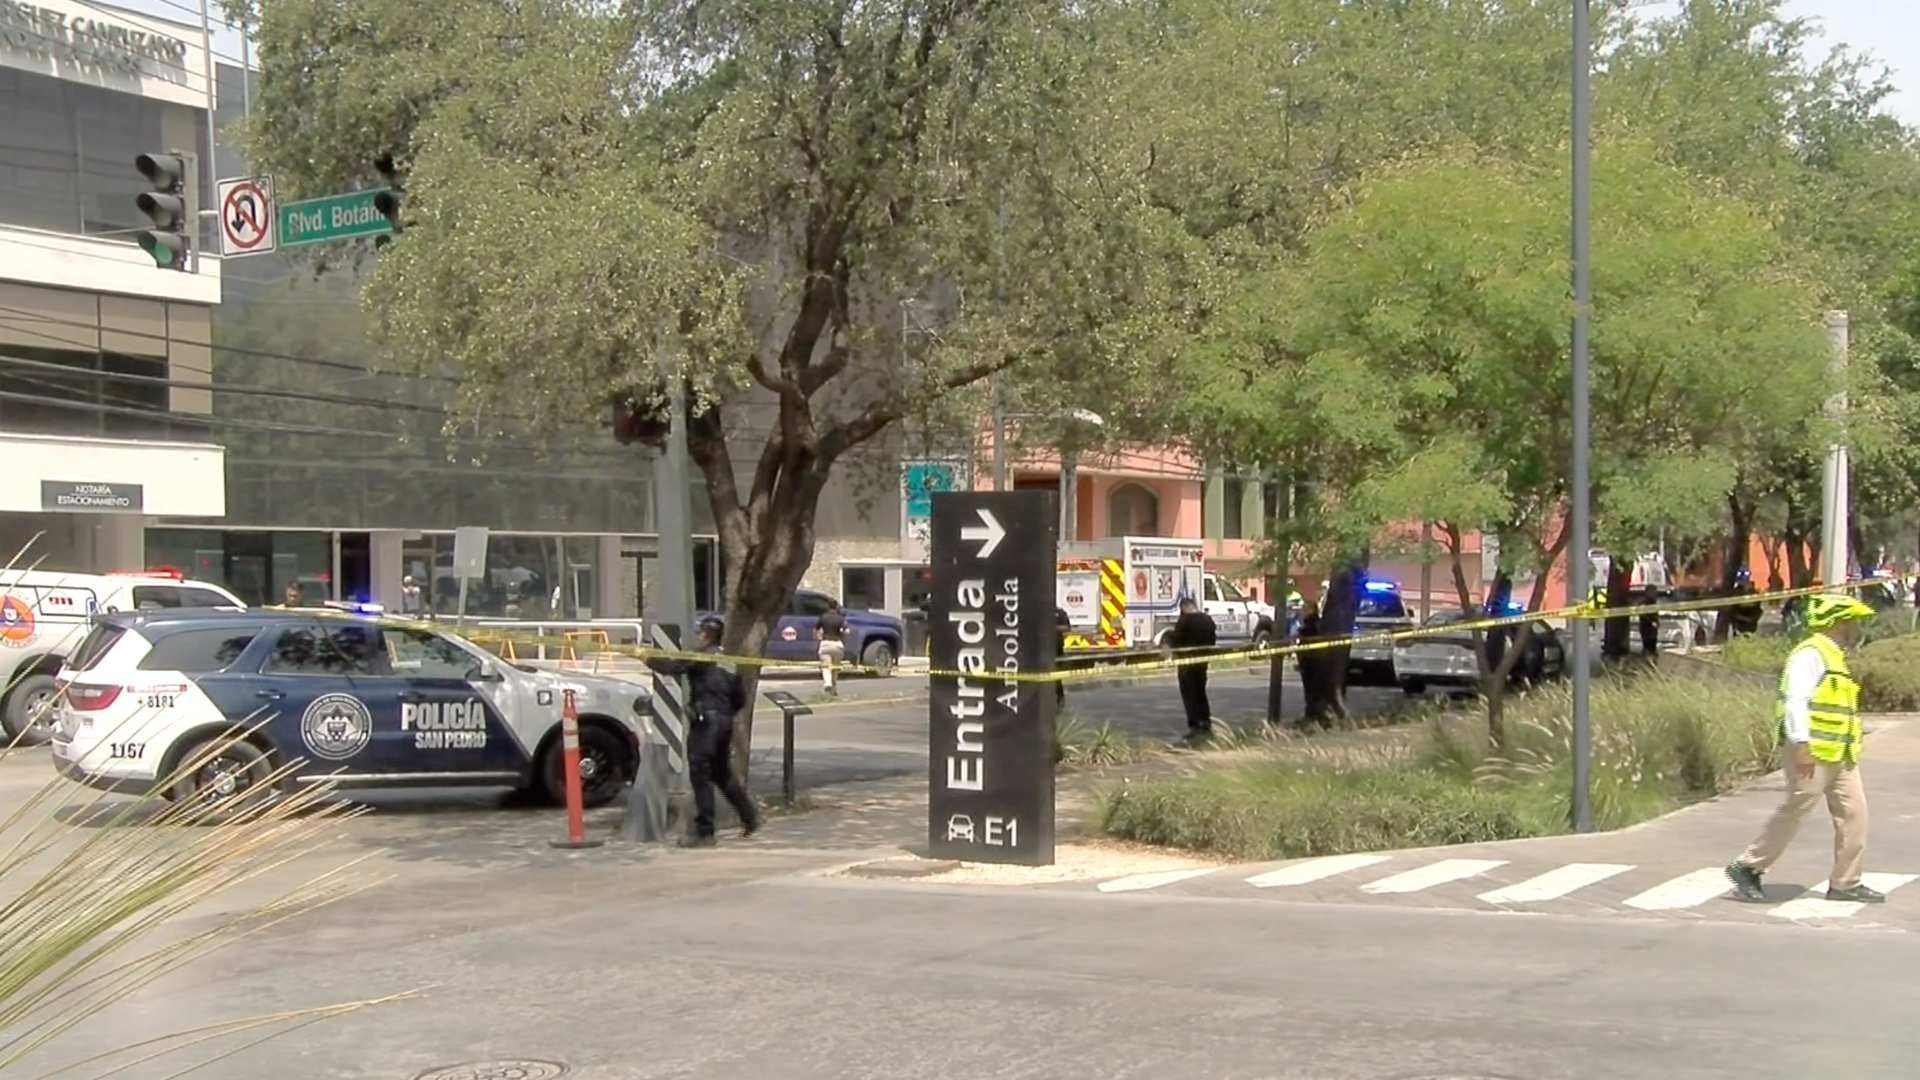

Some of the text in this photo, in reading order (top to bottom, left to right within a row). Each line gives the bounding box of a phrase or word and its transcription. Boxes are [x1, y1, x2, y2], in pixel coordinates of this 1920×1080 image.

[288, 208, 327, 233] Blvd.
[57, 495, 130, 507] ESTACIONAMIENTO
[75, 484, 112, 495] NOTARÍA
[995, 577, 1020, 713] Arboleda
[946, 578, 986, 792] Entrada
[401, 697, 487, 731] POLICÍA
[110, 742, 146, 759] 1167
[415, 731, 487, 749] SAN PEDRO
[984, 816, 1018, 847] E1
